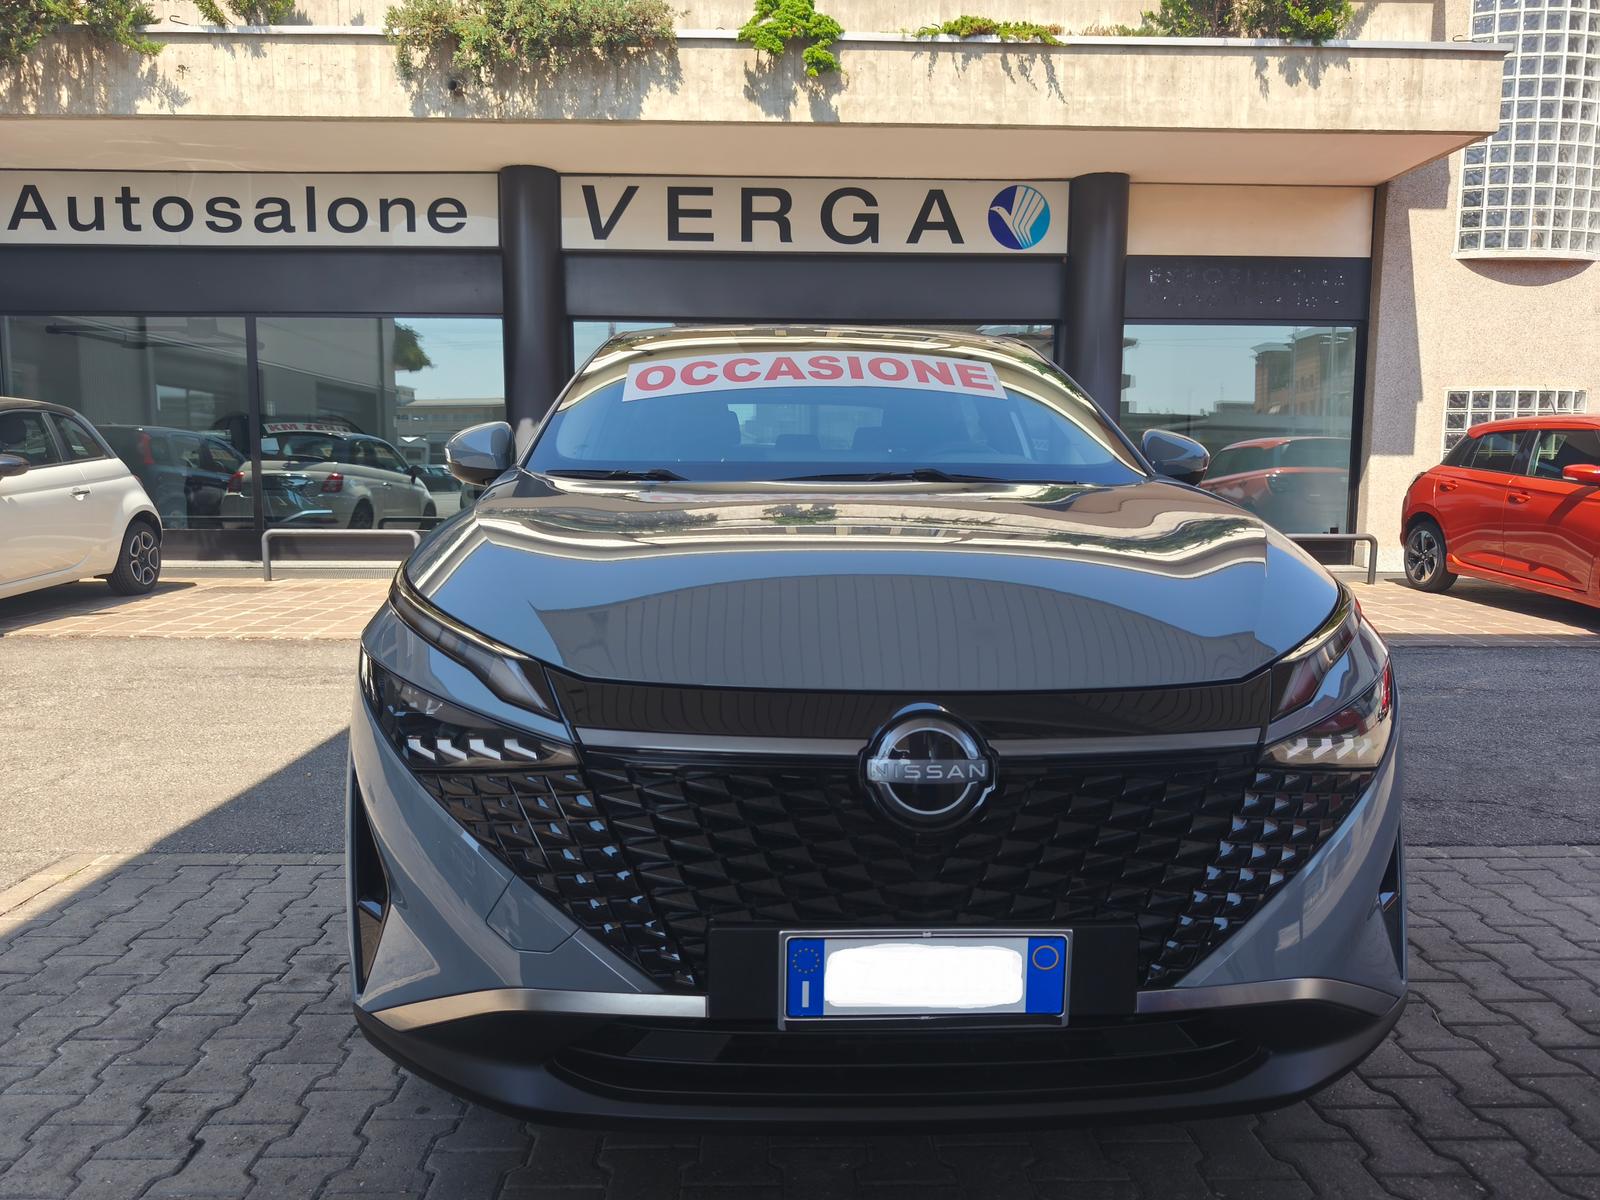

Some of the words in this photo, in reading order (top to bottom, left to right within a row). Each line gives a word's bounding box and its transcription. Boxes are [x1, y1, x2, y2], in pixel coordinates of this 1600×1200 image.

[7, 184, 468, 233] Autosalone
[581, 185, 965, 245] VERGA
[635, 355, 995, 391] OCCASIONE
[268, 423, 298, 432] KM
[870, 763, 986, 779] NISSAN
[802, 980, 809, 1007] I
